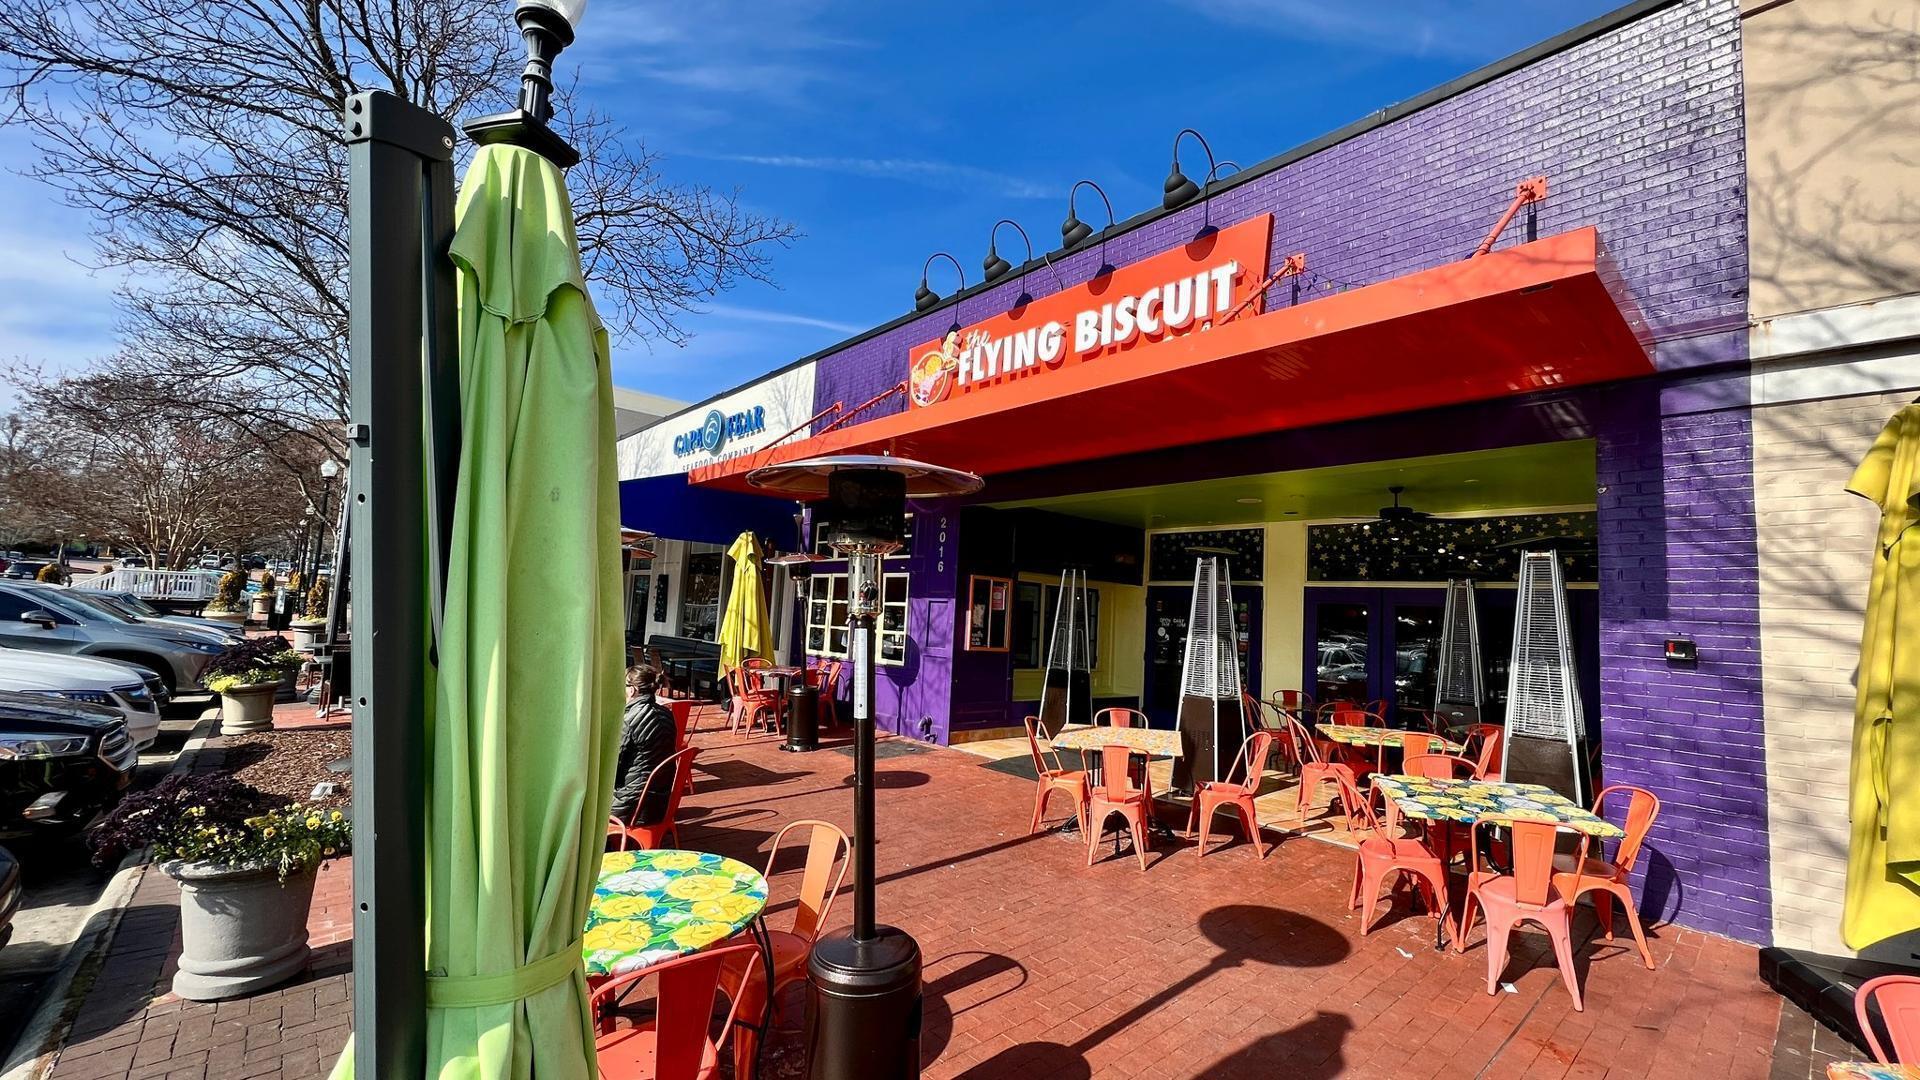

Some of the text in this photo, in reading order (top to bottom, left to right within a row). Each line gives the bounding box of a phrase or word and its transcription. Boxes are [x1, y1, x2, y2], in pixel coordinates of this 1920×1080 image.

[958, 260, 1238, 386] FLYING BISCUIT
[965, 329, 992, 348] the
[674, 405, 766, 455] CAPE FEAR
[718, 446, 755, 463] COMPANY
[938, 517, 947, 573] 2016
